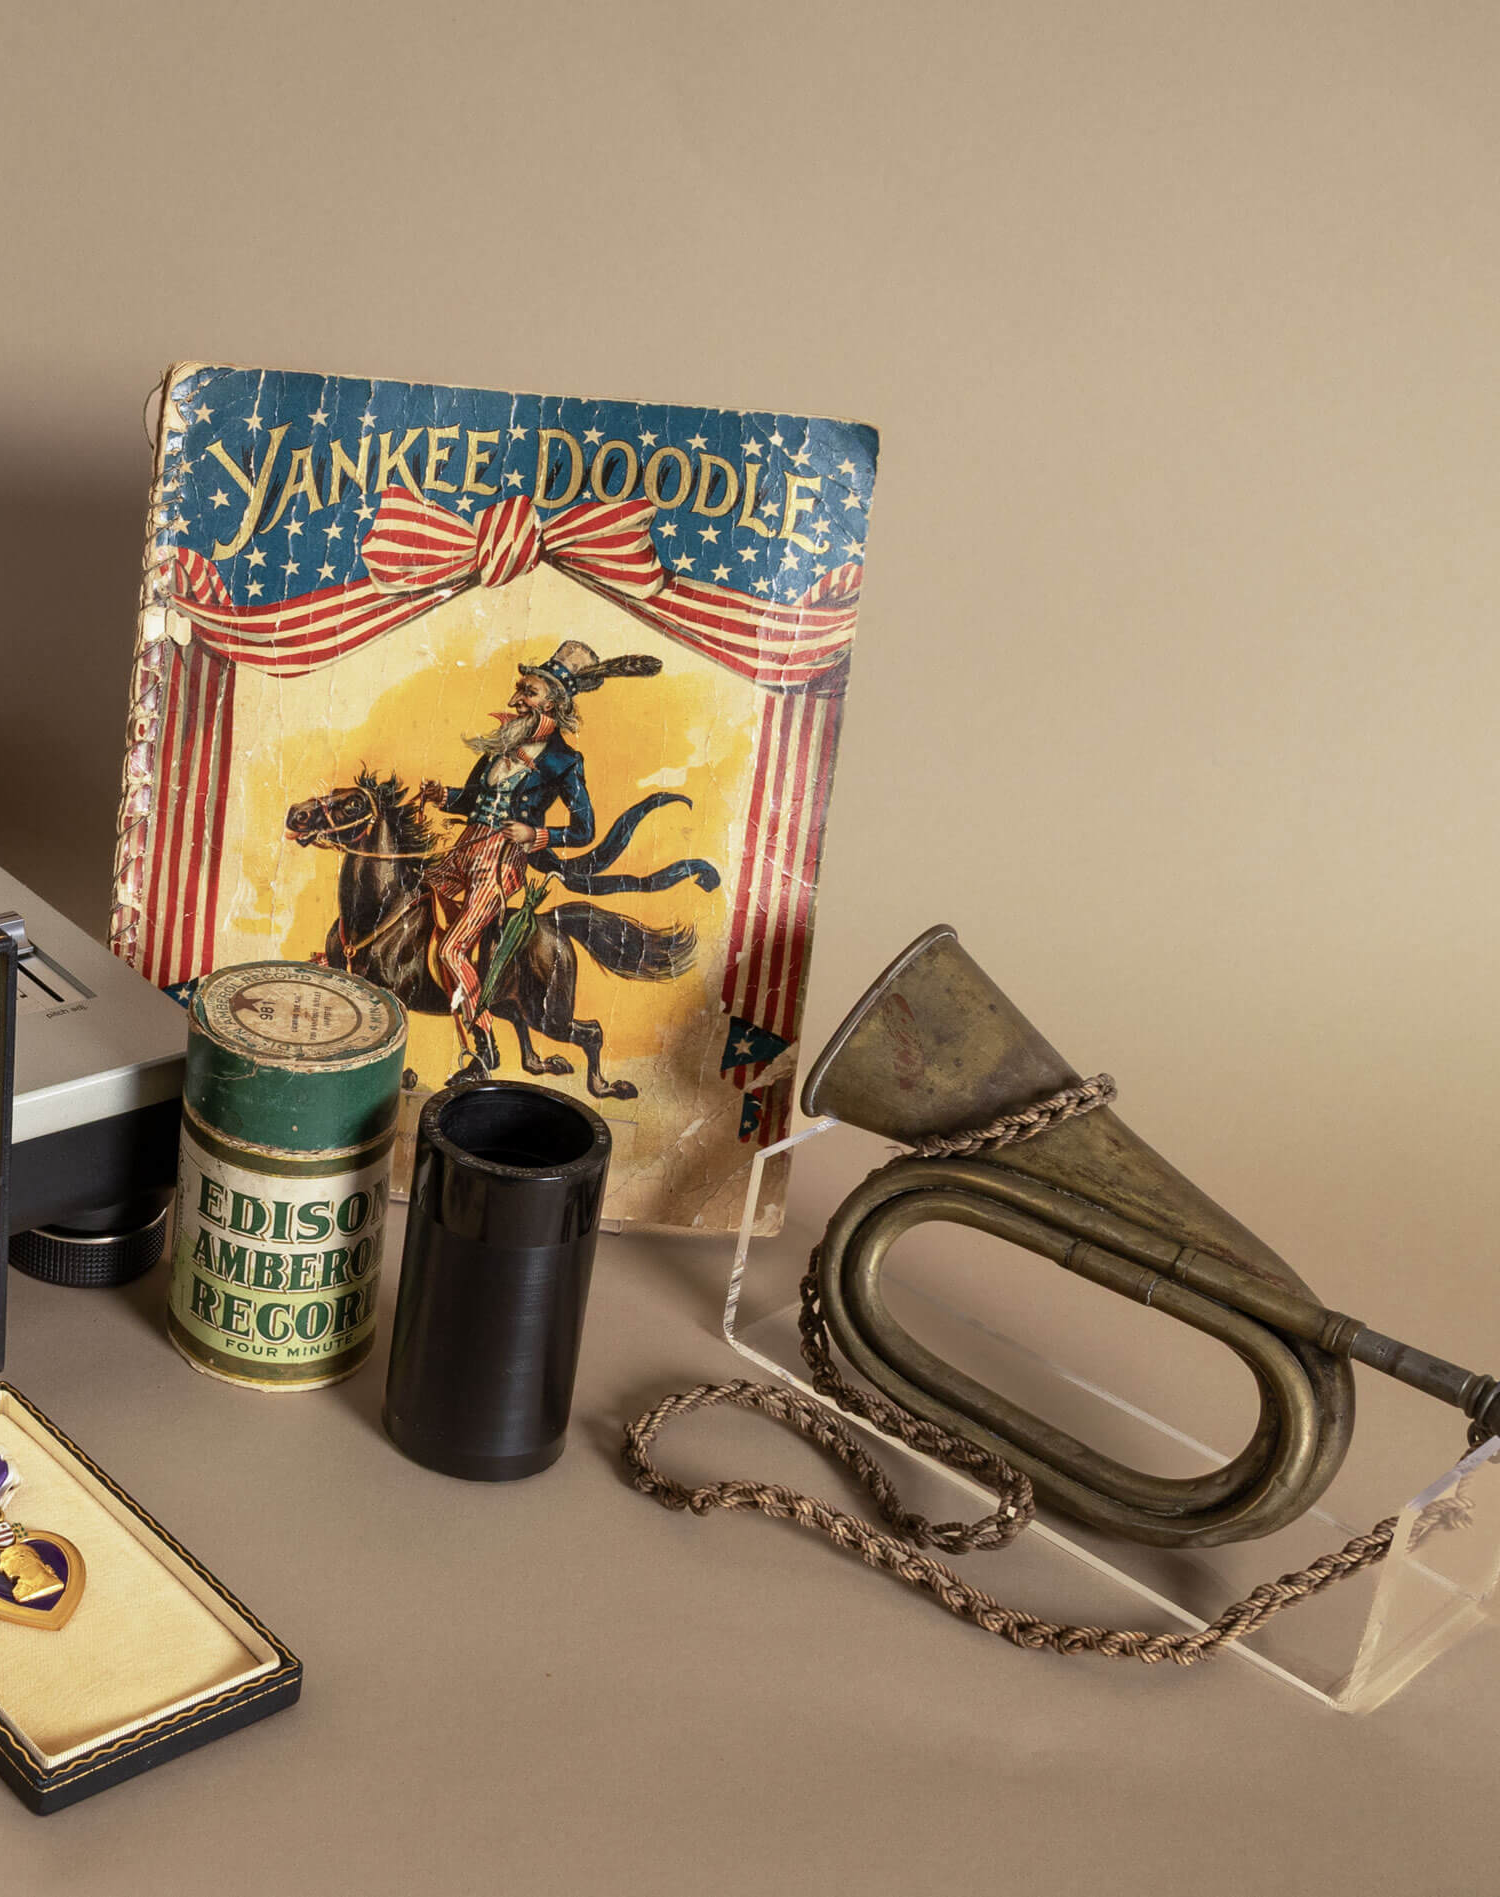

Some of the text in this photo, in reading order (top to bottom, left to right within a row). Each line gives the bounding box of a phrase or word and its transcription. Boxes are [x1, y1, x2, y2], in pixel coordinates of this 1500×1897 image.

[204, 421, 830, 561] YANKEE DOODLE
[242, 971, 312, 987] RECORD
[259, 1000, 277, 1021] 981
[225, 1338, 278, 1357] FOUR
